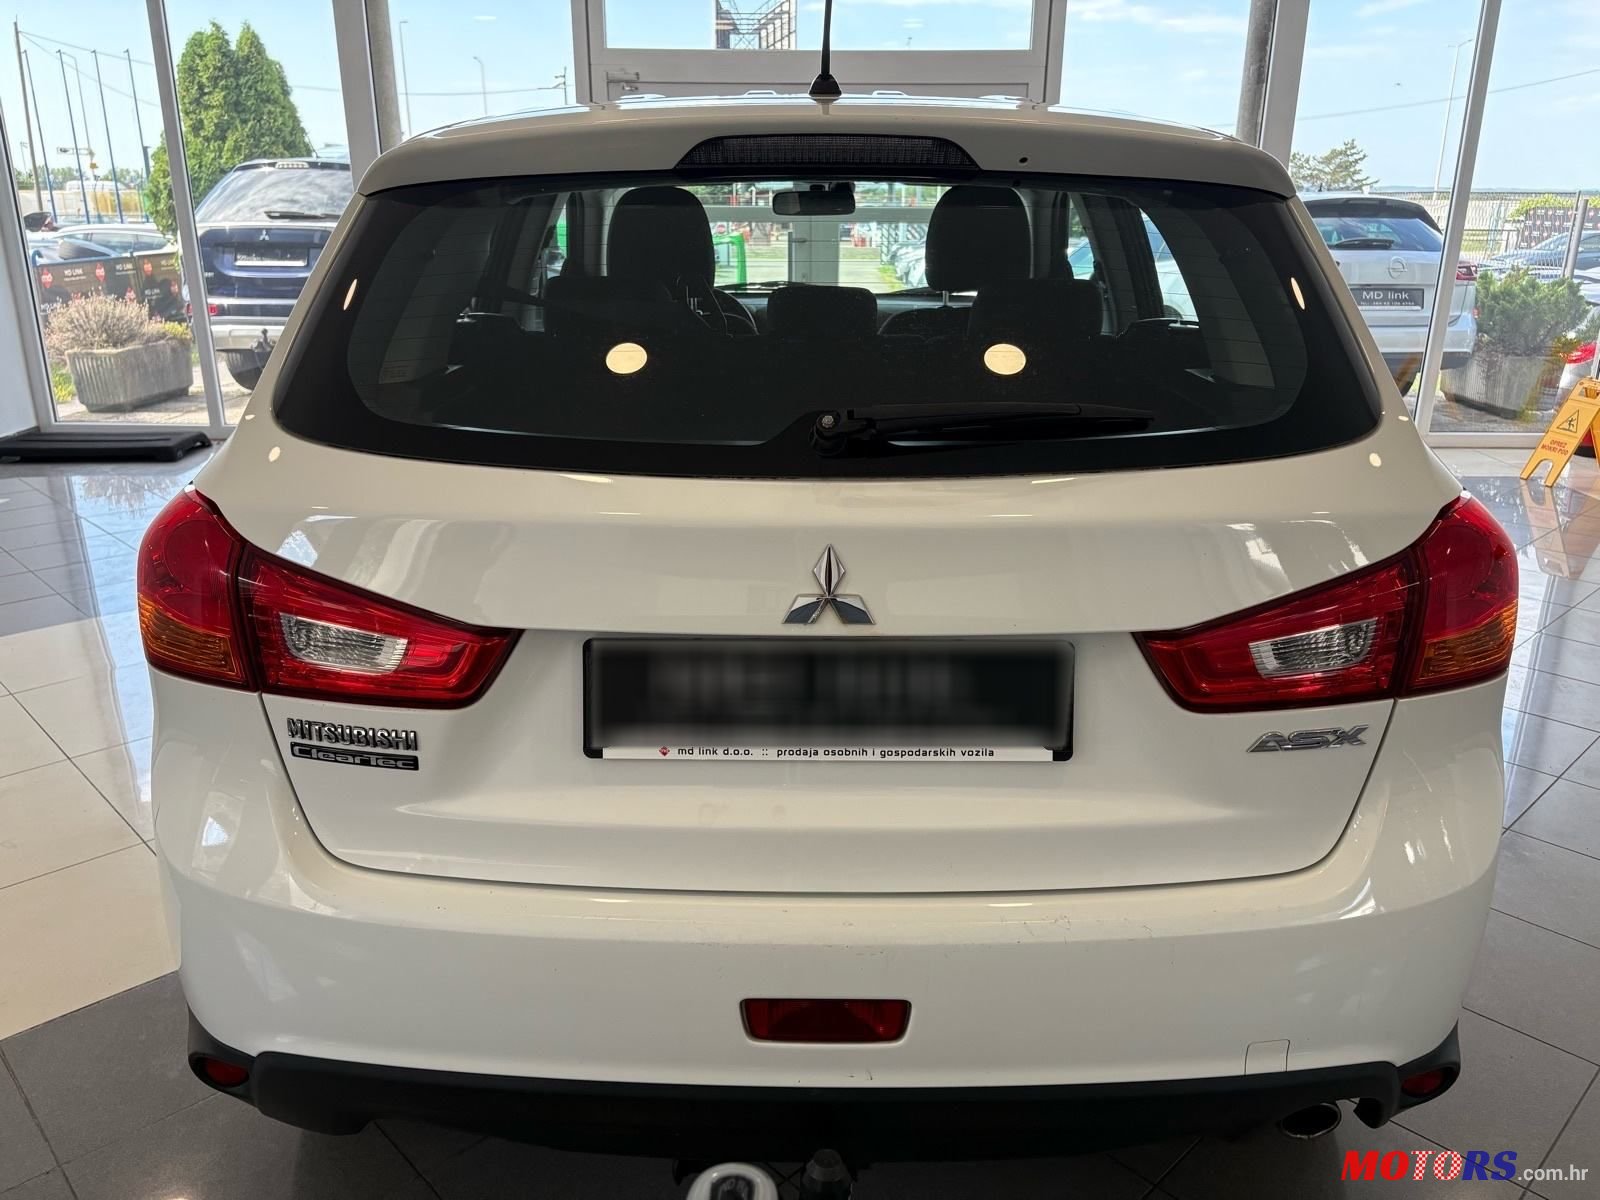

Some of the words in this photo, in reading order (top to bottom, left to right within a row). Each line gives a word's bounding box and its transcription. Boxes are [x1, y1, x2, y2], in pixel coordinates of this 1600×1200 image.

[1362, 290, 1384, 300] MD
[1388, 290, 1409, 300] link
[286, 717, 418, 751] MITSUBISHI
[1246, 724, 1369, 753] ASX
[293, 745, 416, 769] ClearTec
[677, 746, 694, 756] md
[698, 746, 718, 756] link
[723, 746, 753, 756] d.o.o.
[777, 747, 819, 758] prodaja
[823, 747, 868, 757] osobnih
[880, 747, 956, 759] gospodarskih
[960, 747, 995, 757] vozila
